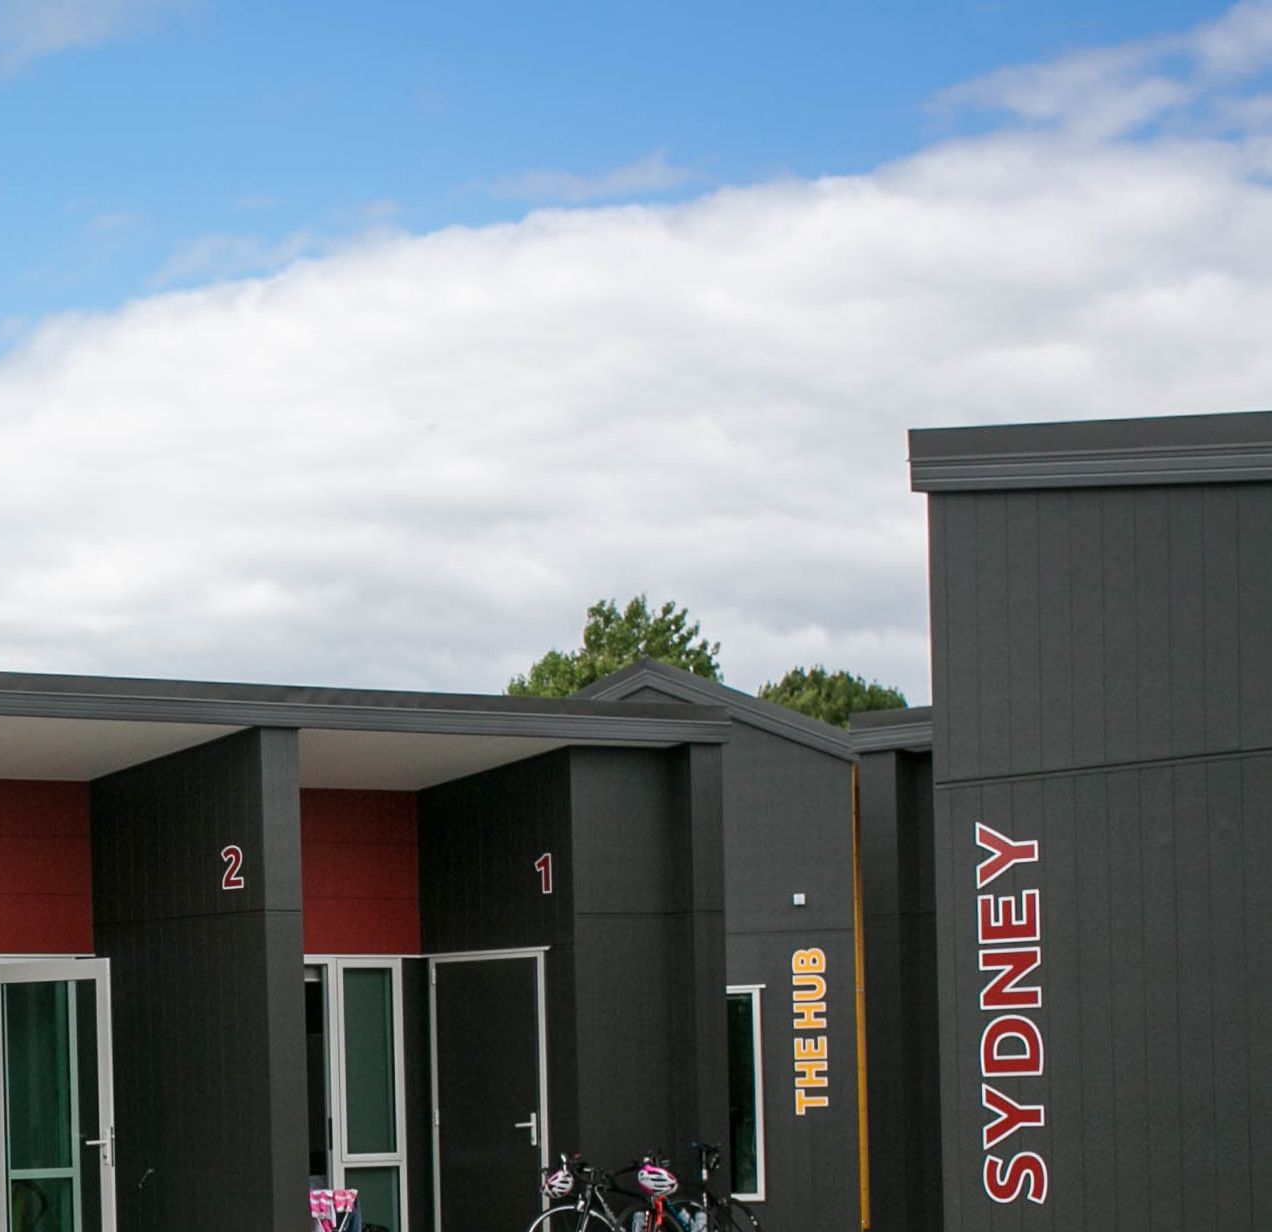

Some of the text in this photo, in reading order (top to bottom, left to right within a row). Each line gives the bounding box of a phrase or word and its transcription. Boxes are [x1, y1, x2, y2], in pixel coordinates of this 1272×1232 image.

[220, 845, 245, 890] 2
[534, 853, 553, 893] 1
[791, 947, 829, 1116] THE HUB
[974, 821, 1049, 1205] SYDNEY
